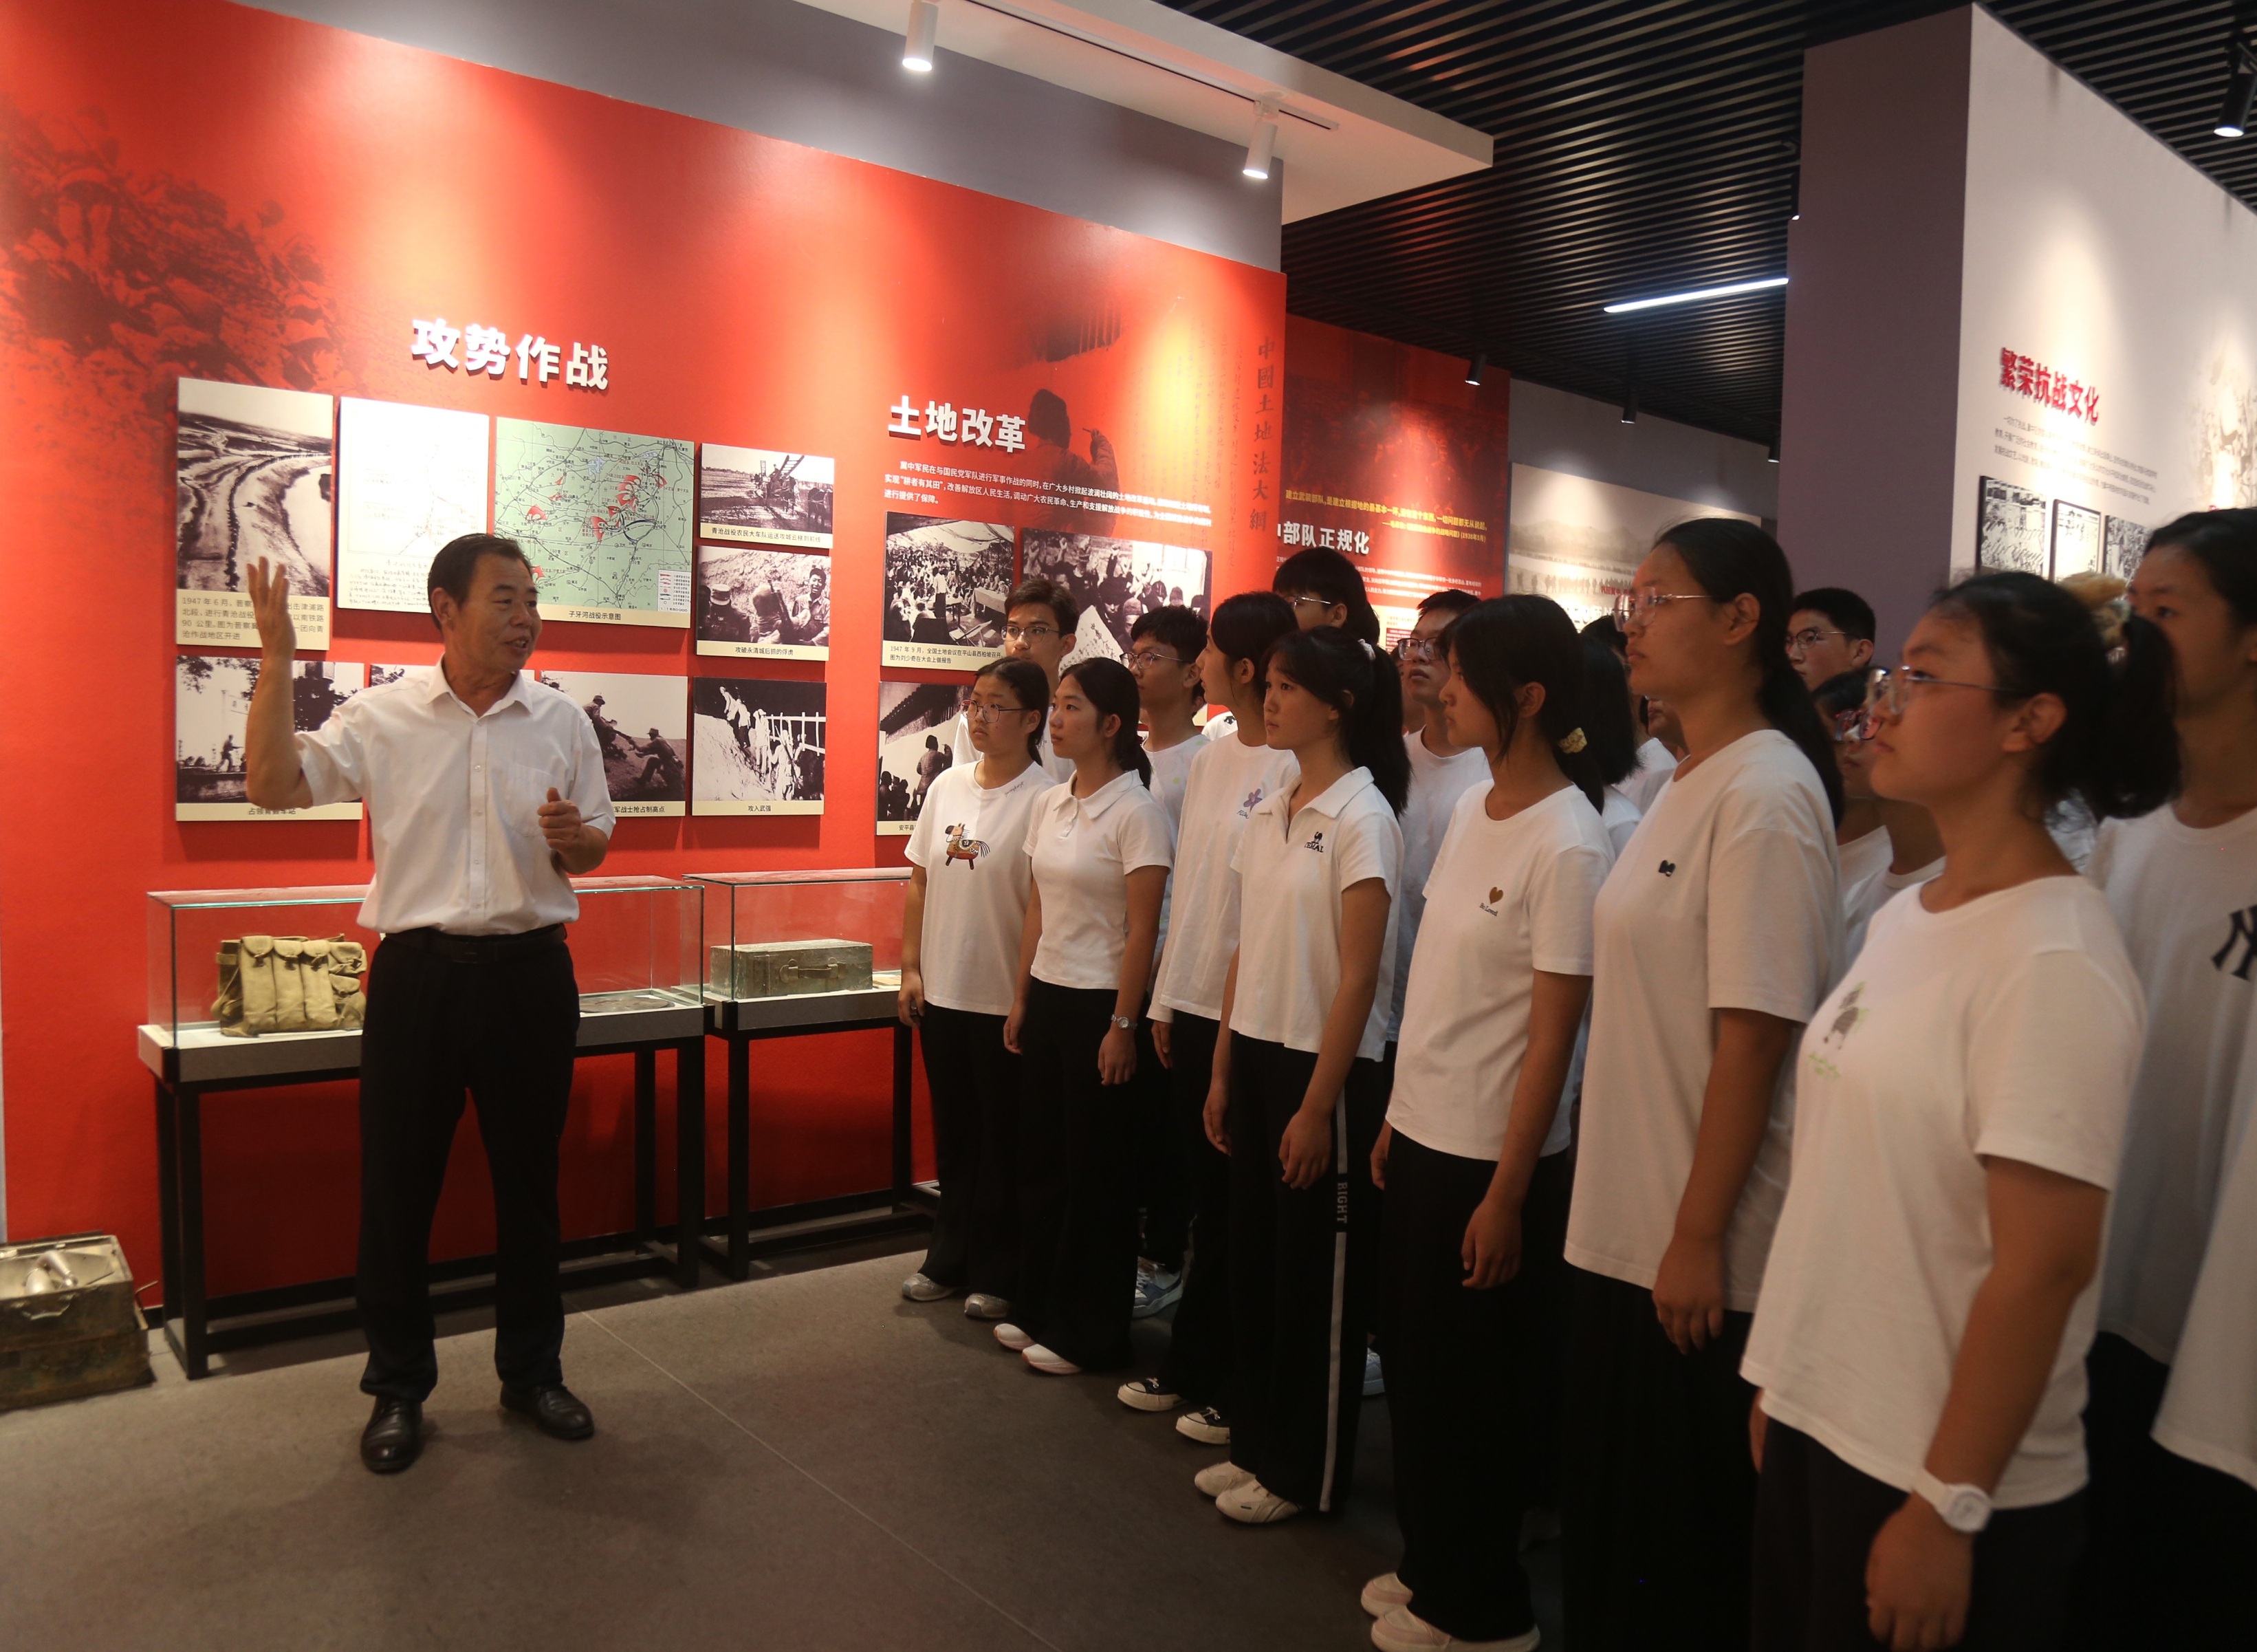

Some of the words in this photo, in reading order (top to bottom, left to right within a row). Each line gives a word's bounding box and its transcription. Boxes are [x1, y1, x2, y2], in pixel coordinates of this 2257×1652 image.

[411, 318, 608, 390] 攻势作战
[2000, 347, 2099, 422] 繁荣抗战文化
[888, 395, 1026, 453] 土地改革
[1249, 336, 1275, 532] 中國土地法大綱
[884, 489, 939, 504] 进行提供了保障。
[711, 527, 821, 543] 青沧战役农民大车队运送攻城云梯到前线
[569, 610, 621, 620] 子牙河战役示意图
[182, 631, 241, 640] 沧作战地区开进
[735, 646, 794, 656] 攻破永清城后抓的俘虏
[890, 654, 952, 664] 图为刘少奇在大会上做报告
[1337, 1182, 1348, 1223] RIGHT
